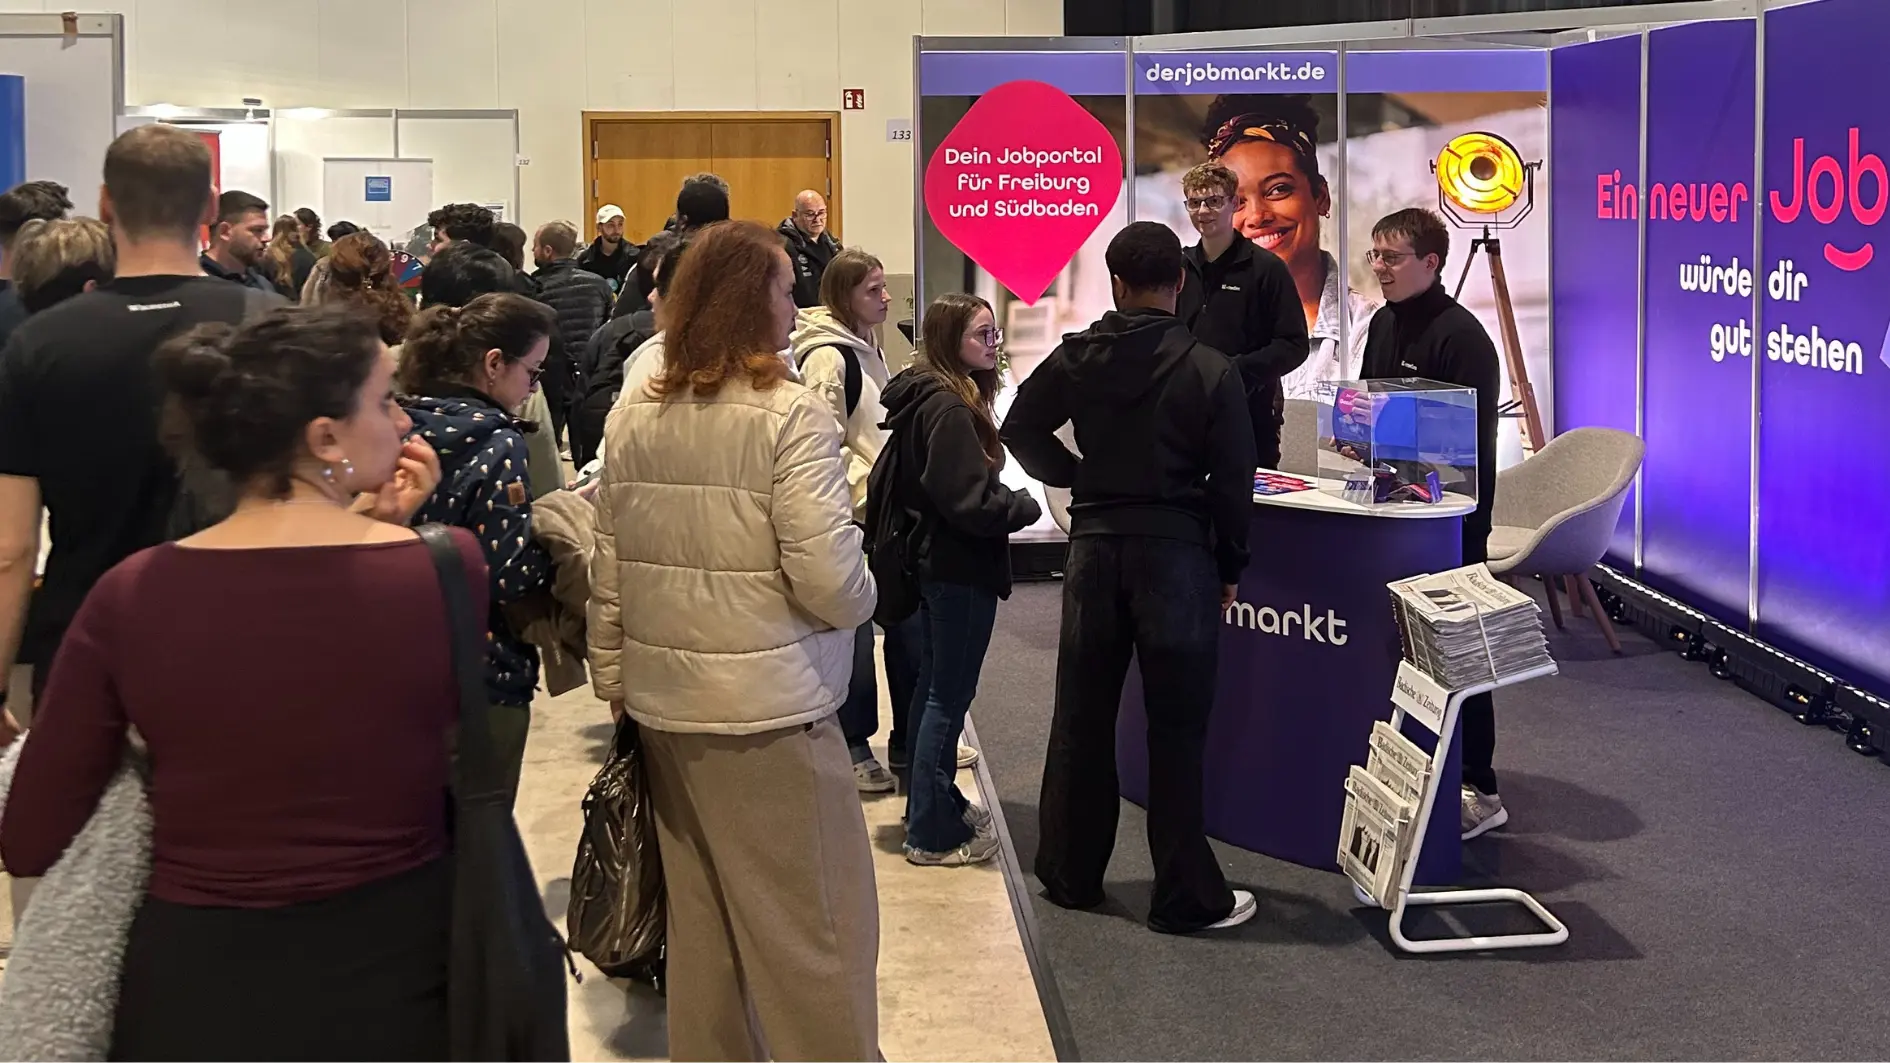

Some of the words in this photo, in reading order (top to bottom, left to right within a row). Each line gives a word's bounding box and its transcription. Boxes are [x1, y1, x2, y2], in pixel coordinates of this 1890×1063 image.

[1146, 62, 1325, 86] derjobmarkt.de
[892, 130, 911, 140] 133
[945, 147, 991, 165] Dein
[997, 146, 1102, 168] Jobportal
[957, 173, 992, 191] für
[998, 173, 1090, 195] Freiburg
[1597, 169, 1637, 220] Ein
[1650, 182, 1748, 223] neuer
[1770, 127, 1889, 226] Job
[950, 200, 988, 217] und
[994, 199, 1099, 217] Südbaden
[1679, 254, 1753, 297] würde
[1768, 259, 1808, 301] dir
[1710, 318, 1751, 362] gut
[1767, 323, 1863, 375] stehen
[1225, 600, 1348, 646] markt
[1422, 694, 1443, 721] Zeitung
